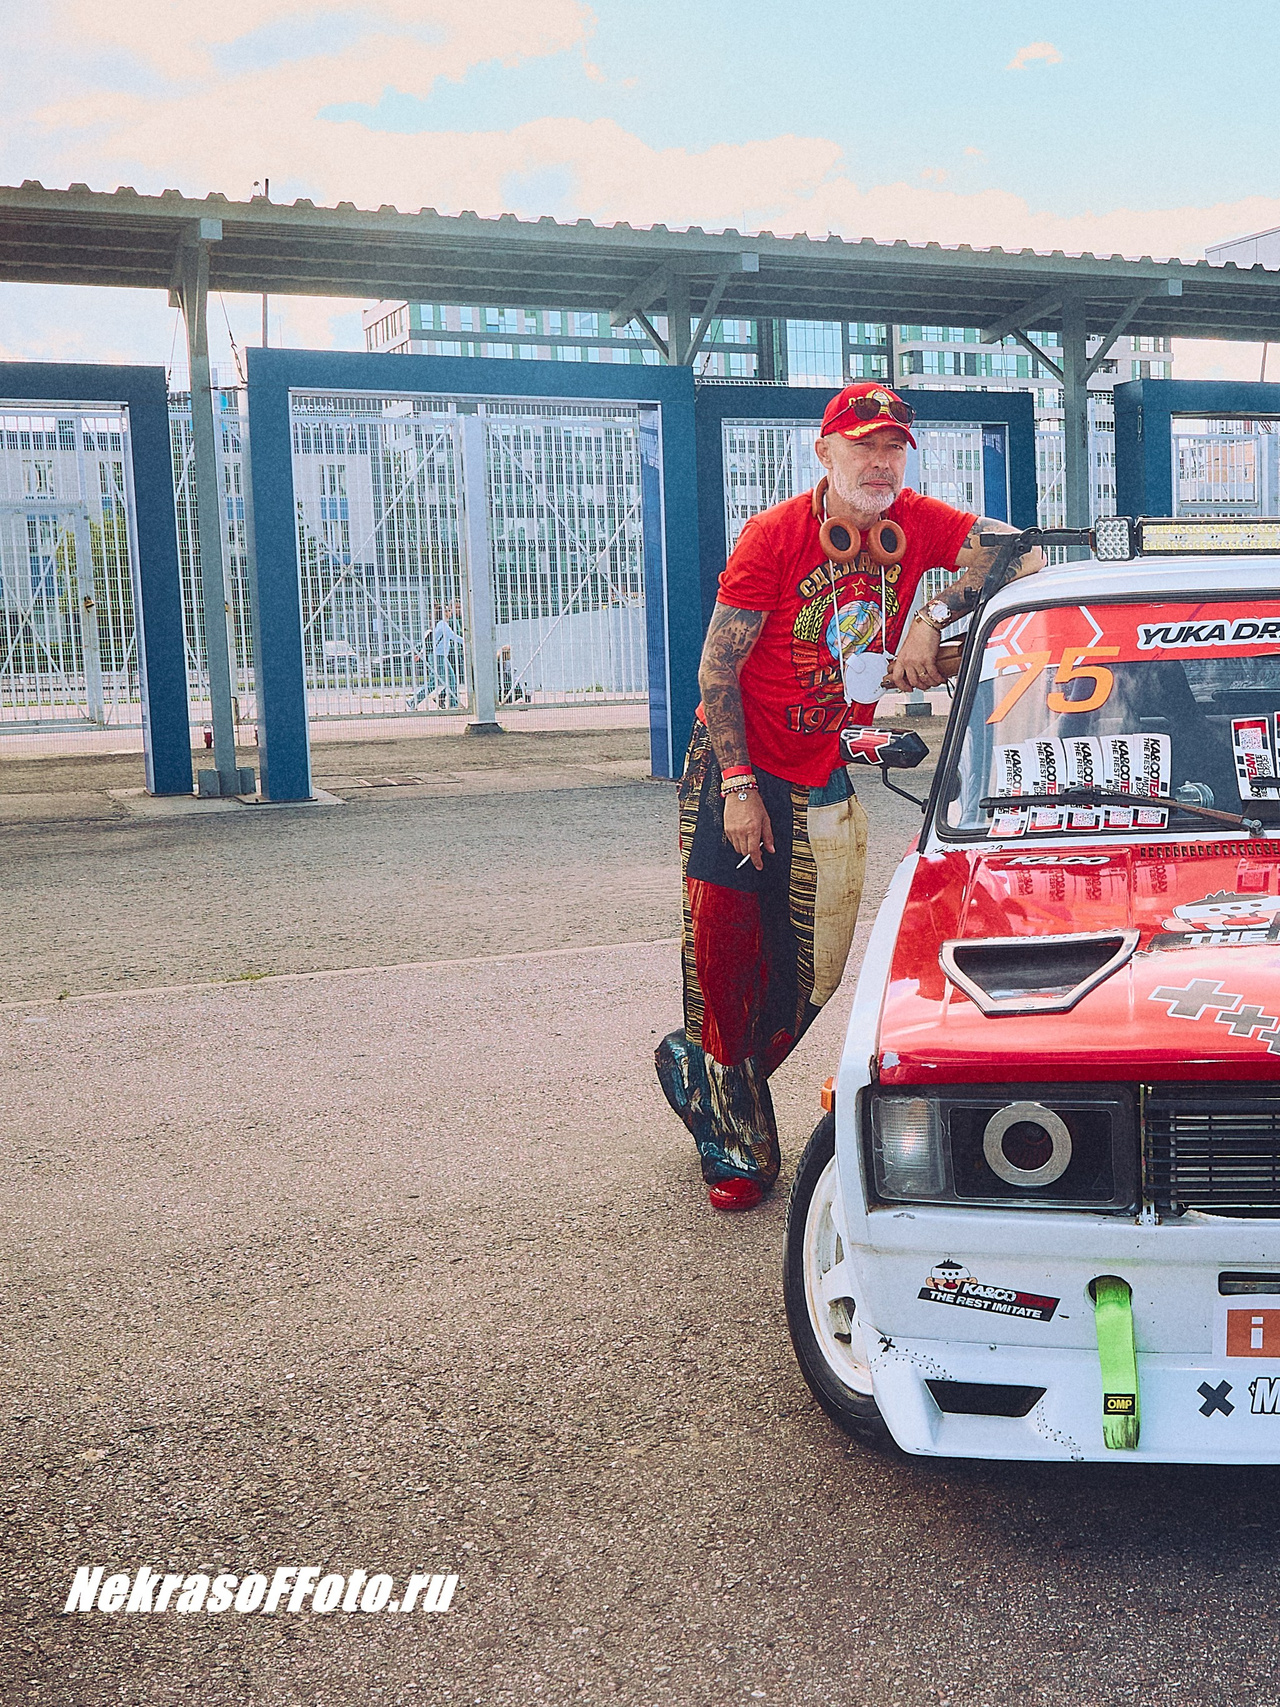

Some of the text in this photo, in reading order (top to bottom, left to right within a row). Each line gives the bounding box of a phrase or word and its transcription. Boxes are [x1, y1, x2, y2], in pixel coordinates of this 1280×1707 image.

[1141, 624, 1227, 646] YUKA
[986, 646, 1120, 725] 75
[788, 703, 854, 733] 197
[1184, 929, 1269, 945] THE
[962, 1283, 1017, 1302] KA&CO
[930, 1290, 1043, 1319] THE REST IMITATE
[1106, 1397, 1134, 1411] OMP
